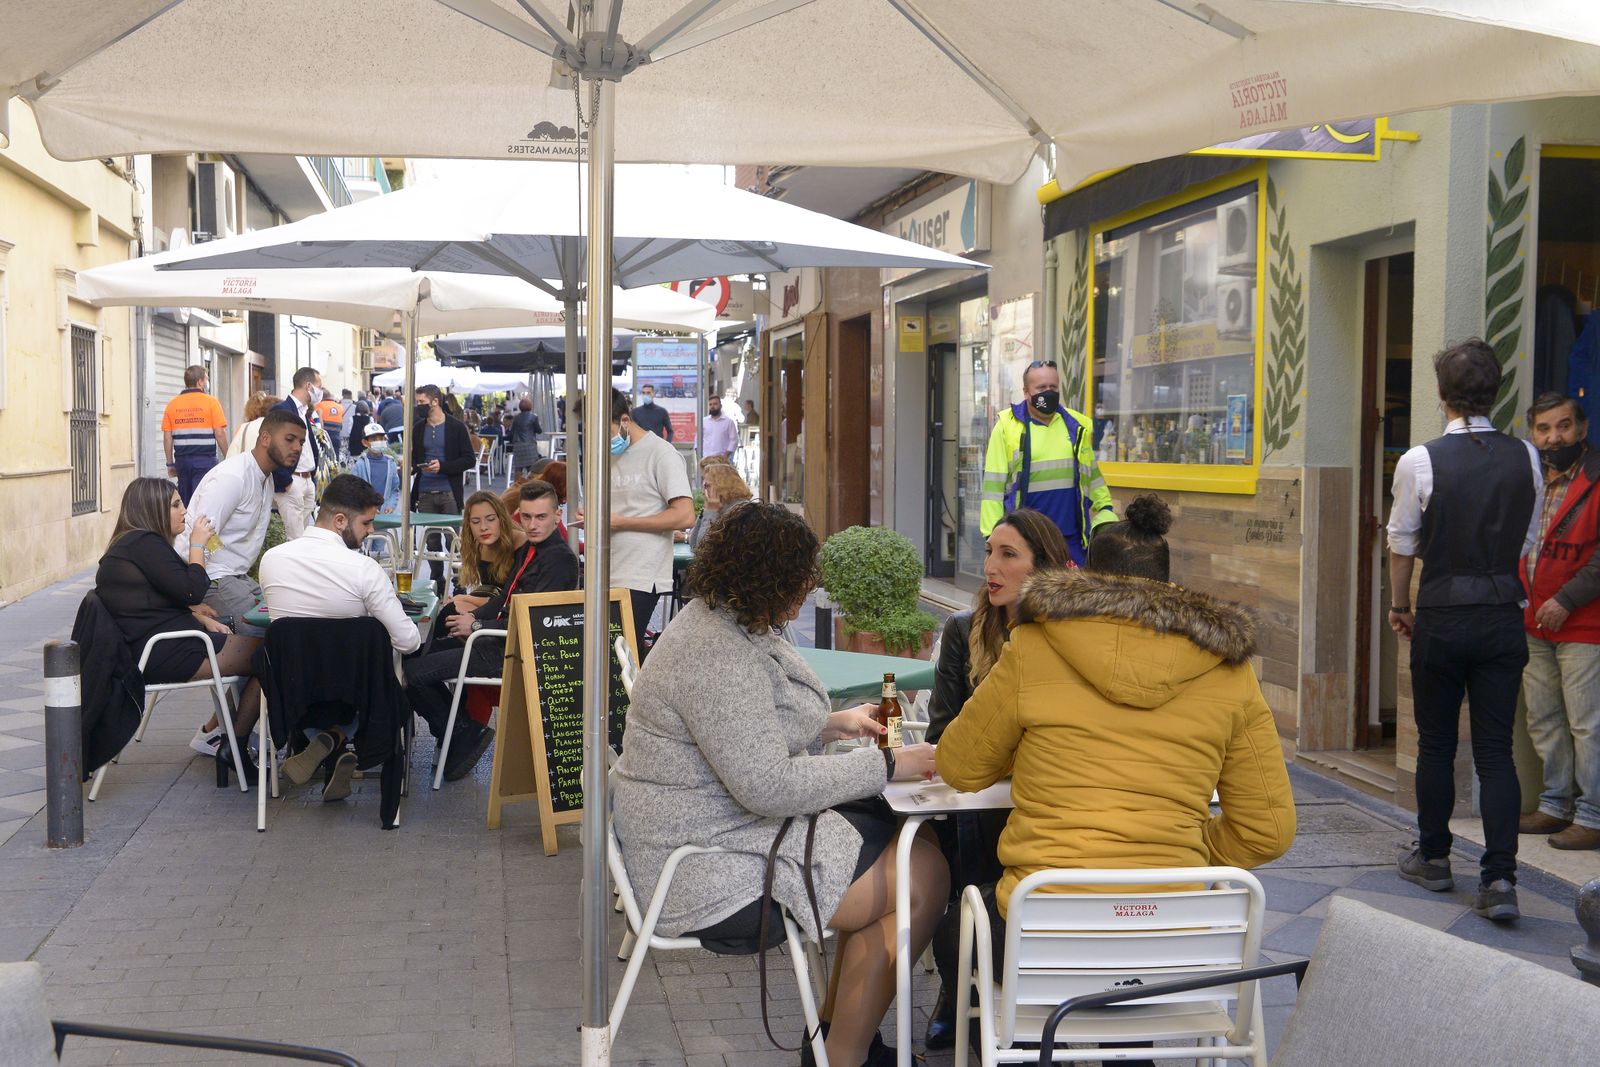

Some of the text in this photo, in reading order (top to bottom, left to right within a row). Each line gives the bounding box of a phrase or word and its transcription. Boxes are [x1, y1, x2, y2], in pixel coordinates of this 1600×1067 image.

[223, 279, 257, 287] VICTORIA
[555, 738, 582, 747] PLANCH
[553, 748, 584, 758] BROCHE
[560, 791, 583, 801] PROVO
